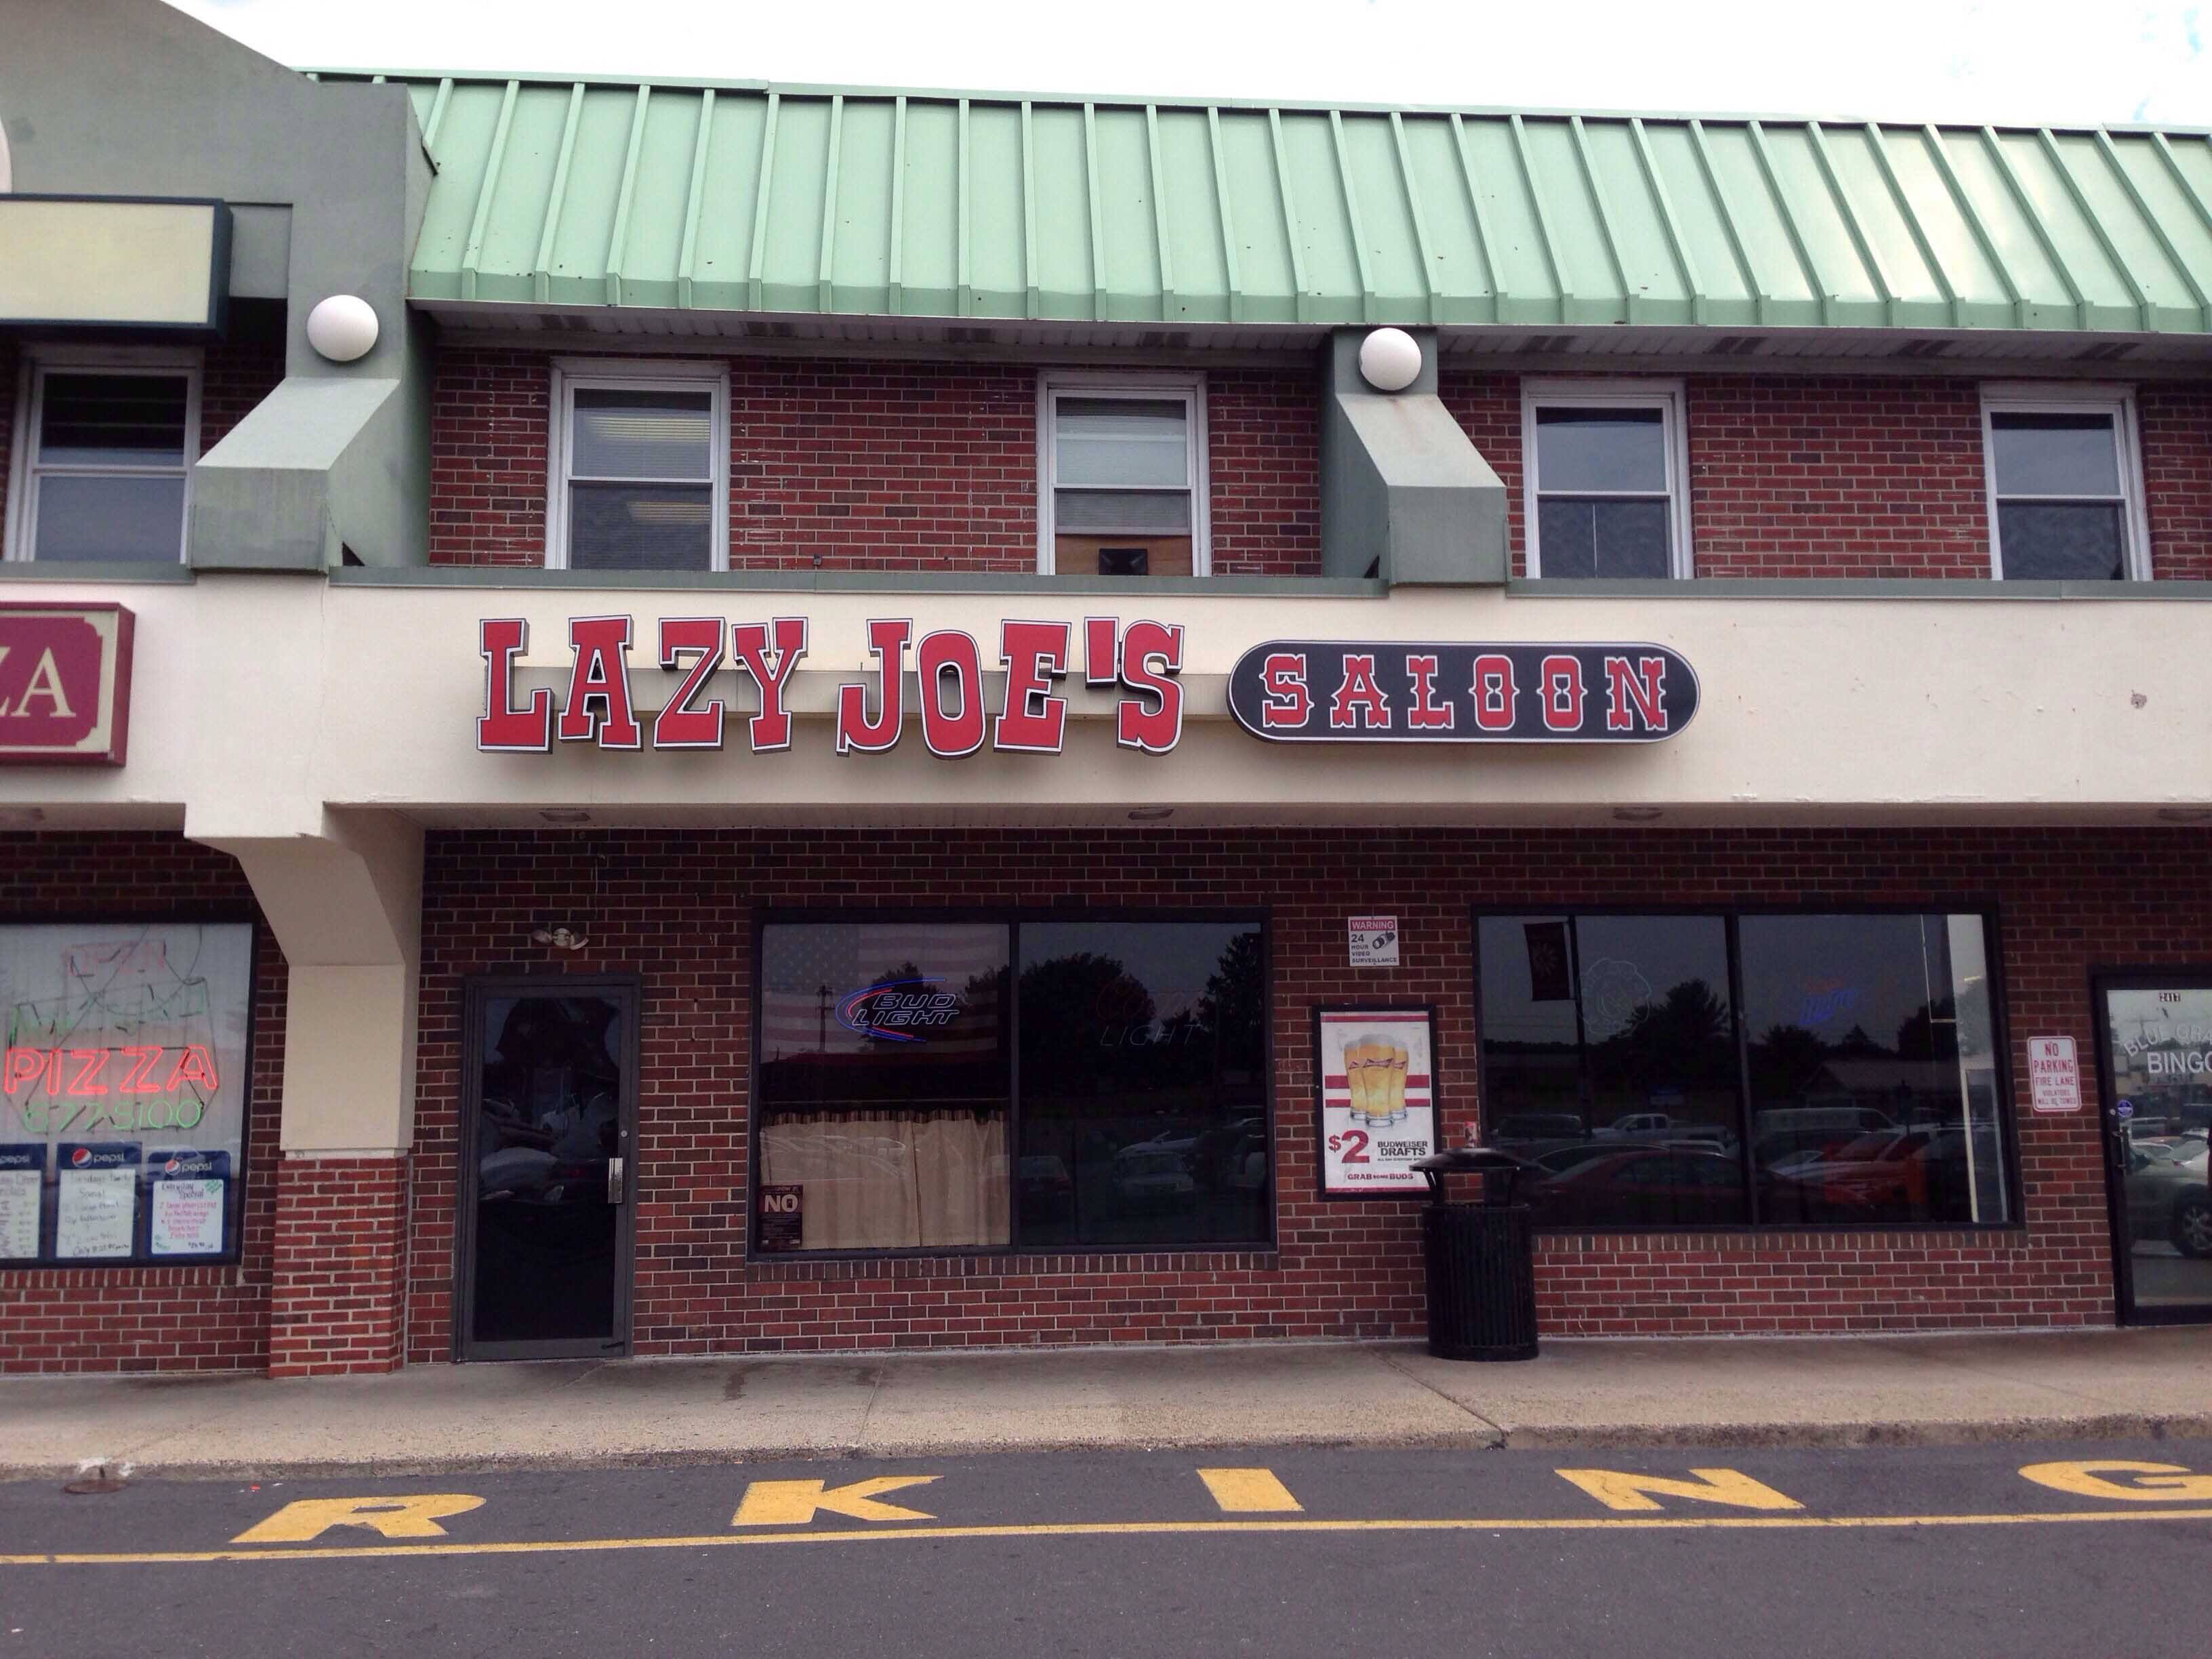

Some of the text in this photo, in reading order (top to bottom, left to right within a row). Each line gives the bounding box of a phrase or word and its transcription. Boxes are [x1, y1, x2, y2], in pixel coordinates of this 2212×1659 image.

[0, 645, 77, 718] A
[476, 615, 1668, 760] LAZY JOE'S SALOON
[1351, 921, 1394, 930] WARNING
[1351, 934, 1364, 943] 24
[872, 993, 956, 1010] BUD
[851, 1008, 960, 1026] LIGHT
[1100, 1023, 1204, 1047] LIGHT
[2045, 1042, 2060, 1057] NO
[3, 1046, 219, 1095] PIZZA
[2034, 1059, 2074, 1073] PARKING
[2035, 1076, 2075, 1086] FIRE LANE
[1328, 1130, 1370, 1164] $2
[1377, 1141, 1429, 1149] BUDWEISER
[1380, 1148, 1427, 1156] DRAFTS
[94, 1152, 125, 1164] pepsi
[182, 1162, 212, 1173] pepsi
[764, 1193, 799, 1213] NO
